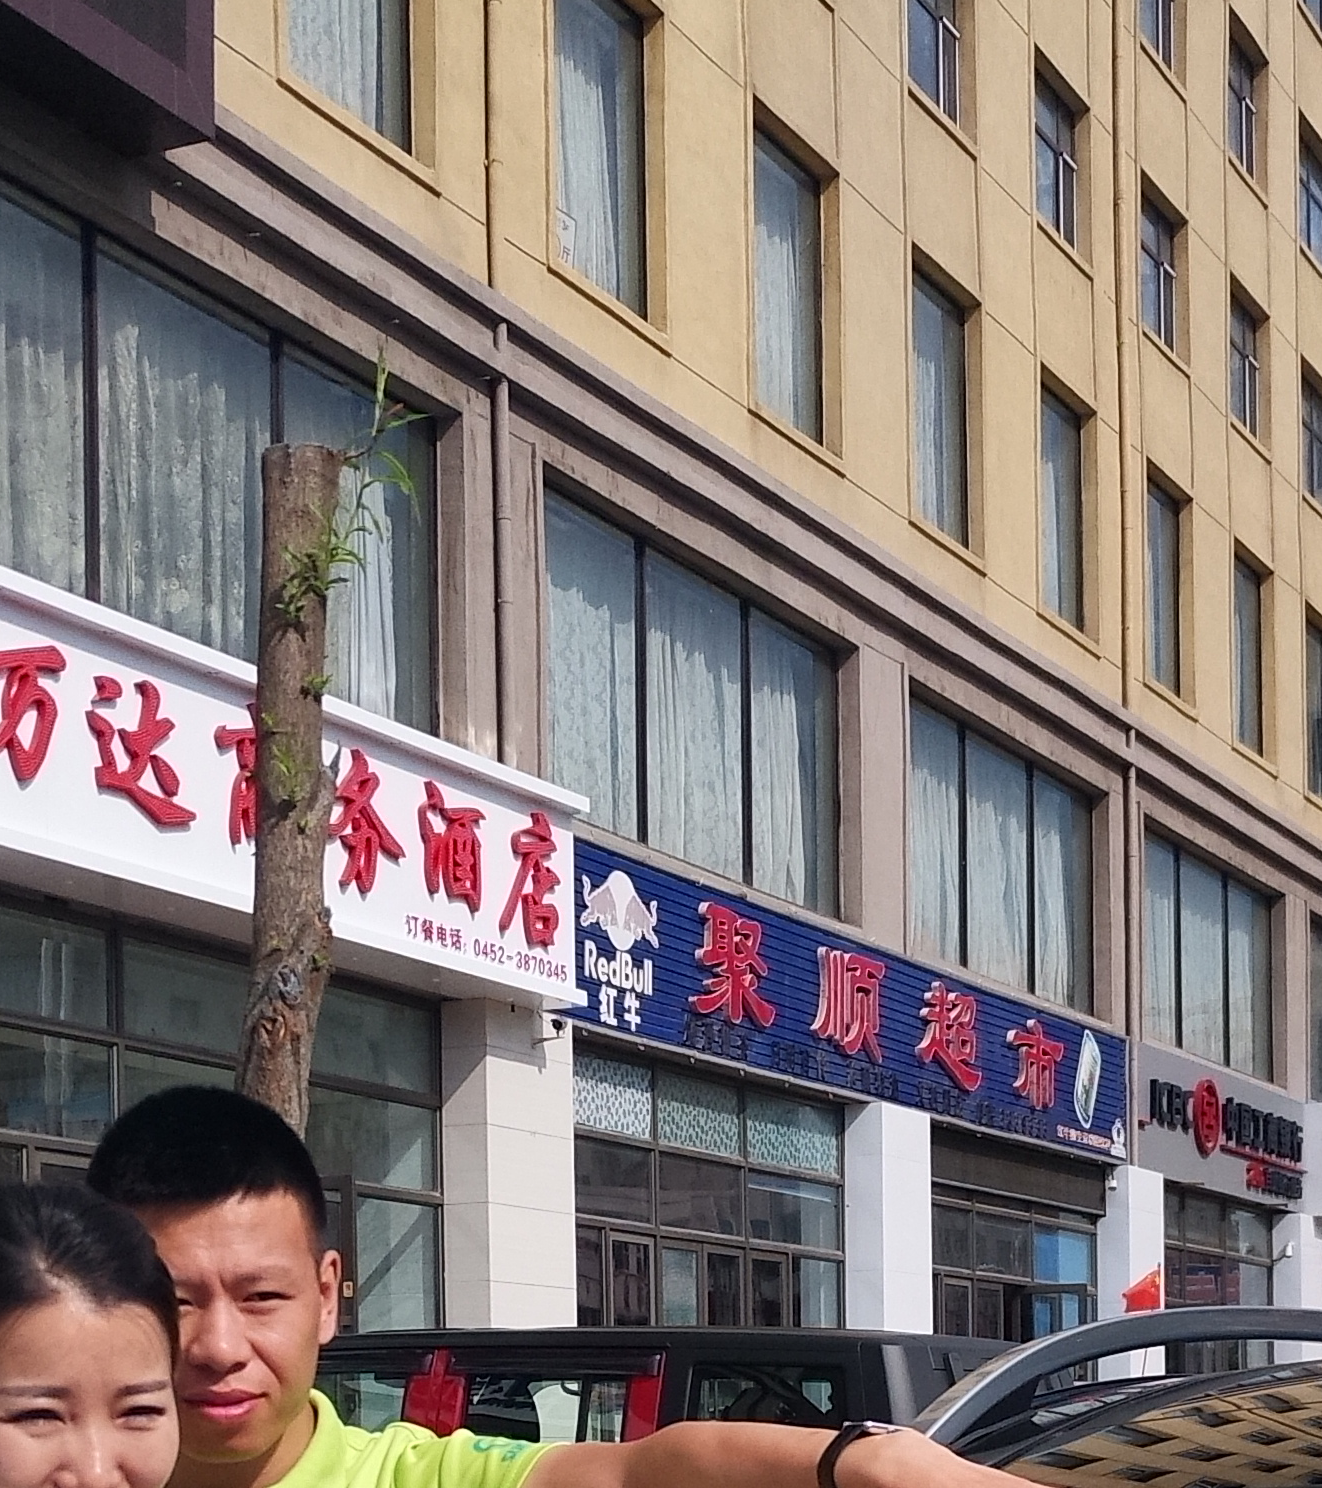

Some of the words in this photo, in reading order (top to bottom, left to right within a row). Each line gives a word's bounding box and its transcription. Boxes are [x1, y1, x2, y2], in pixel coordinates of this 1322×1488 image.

[599, 984, 641, 1032] 红牛
[689, 900, 1065, 1110] 聚顺超市
